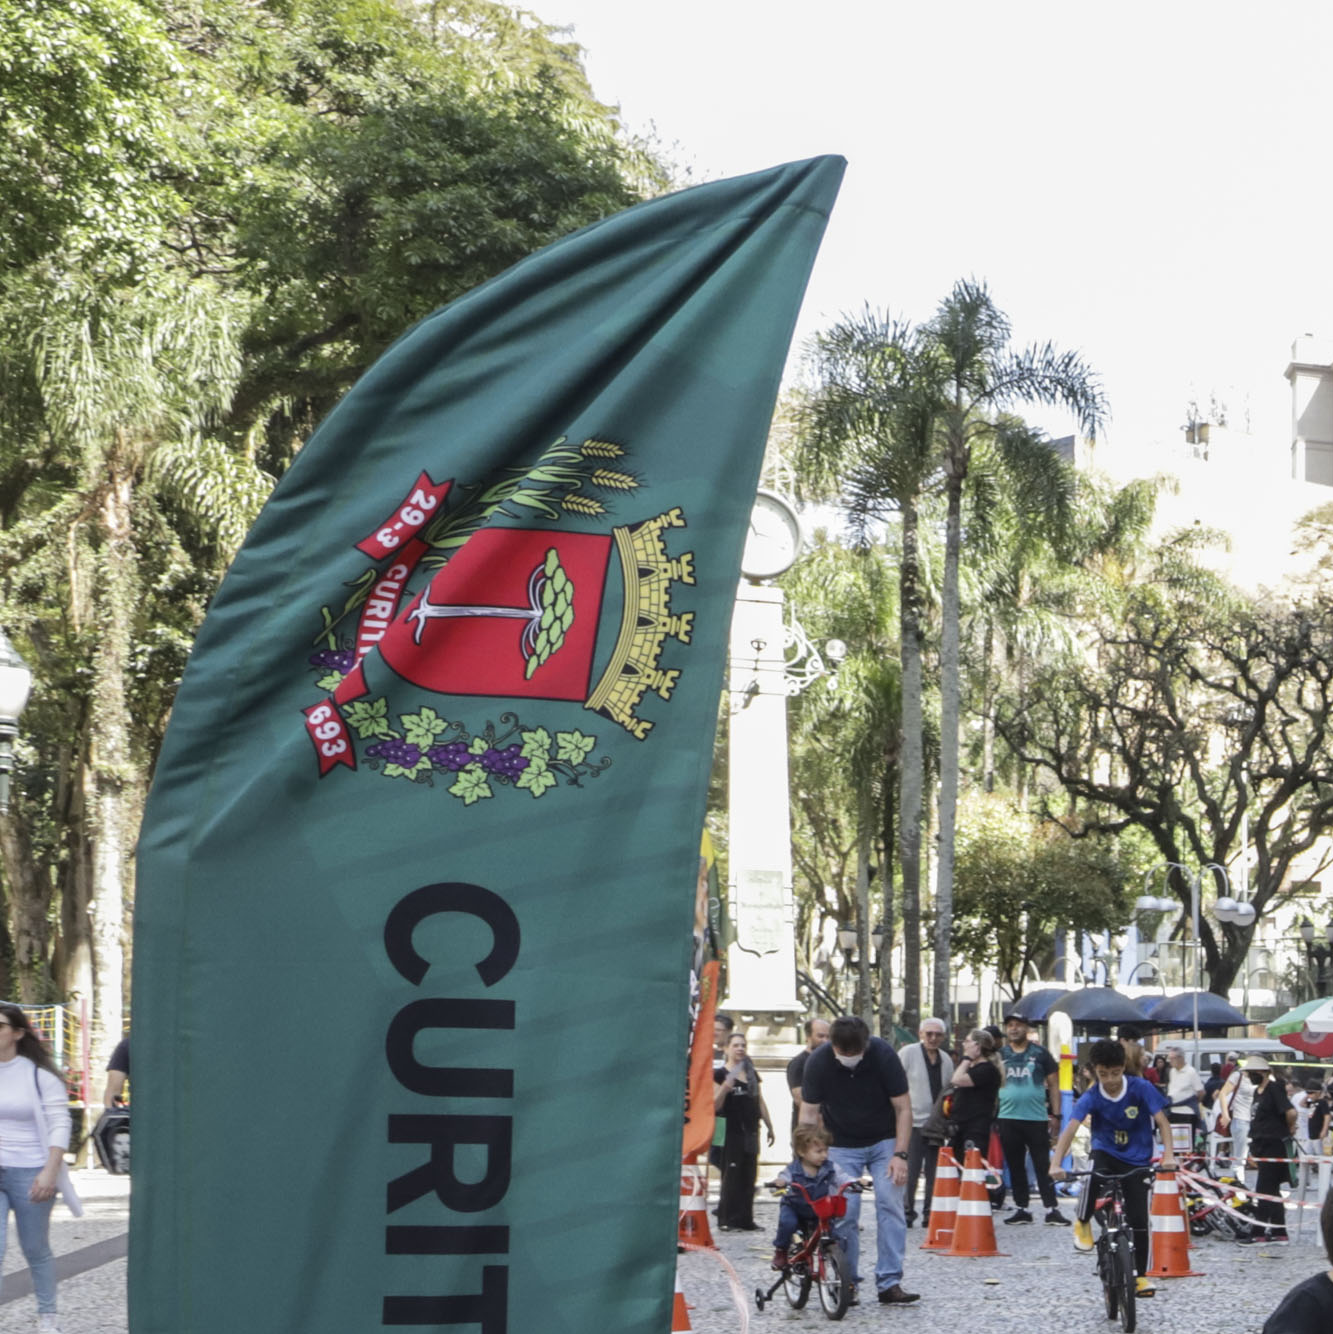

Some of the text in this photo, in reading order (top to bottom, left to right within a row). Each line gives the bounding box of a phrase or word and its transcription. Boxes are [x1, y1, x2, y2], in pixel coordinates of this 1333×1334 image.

[376, 489, 437, 548] 29-3
[1006, 1066, 1032, 1079] AIA
[1114, 1130, 1129, 1145] 10
